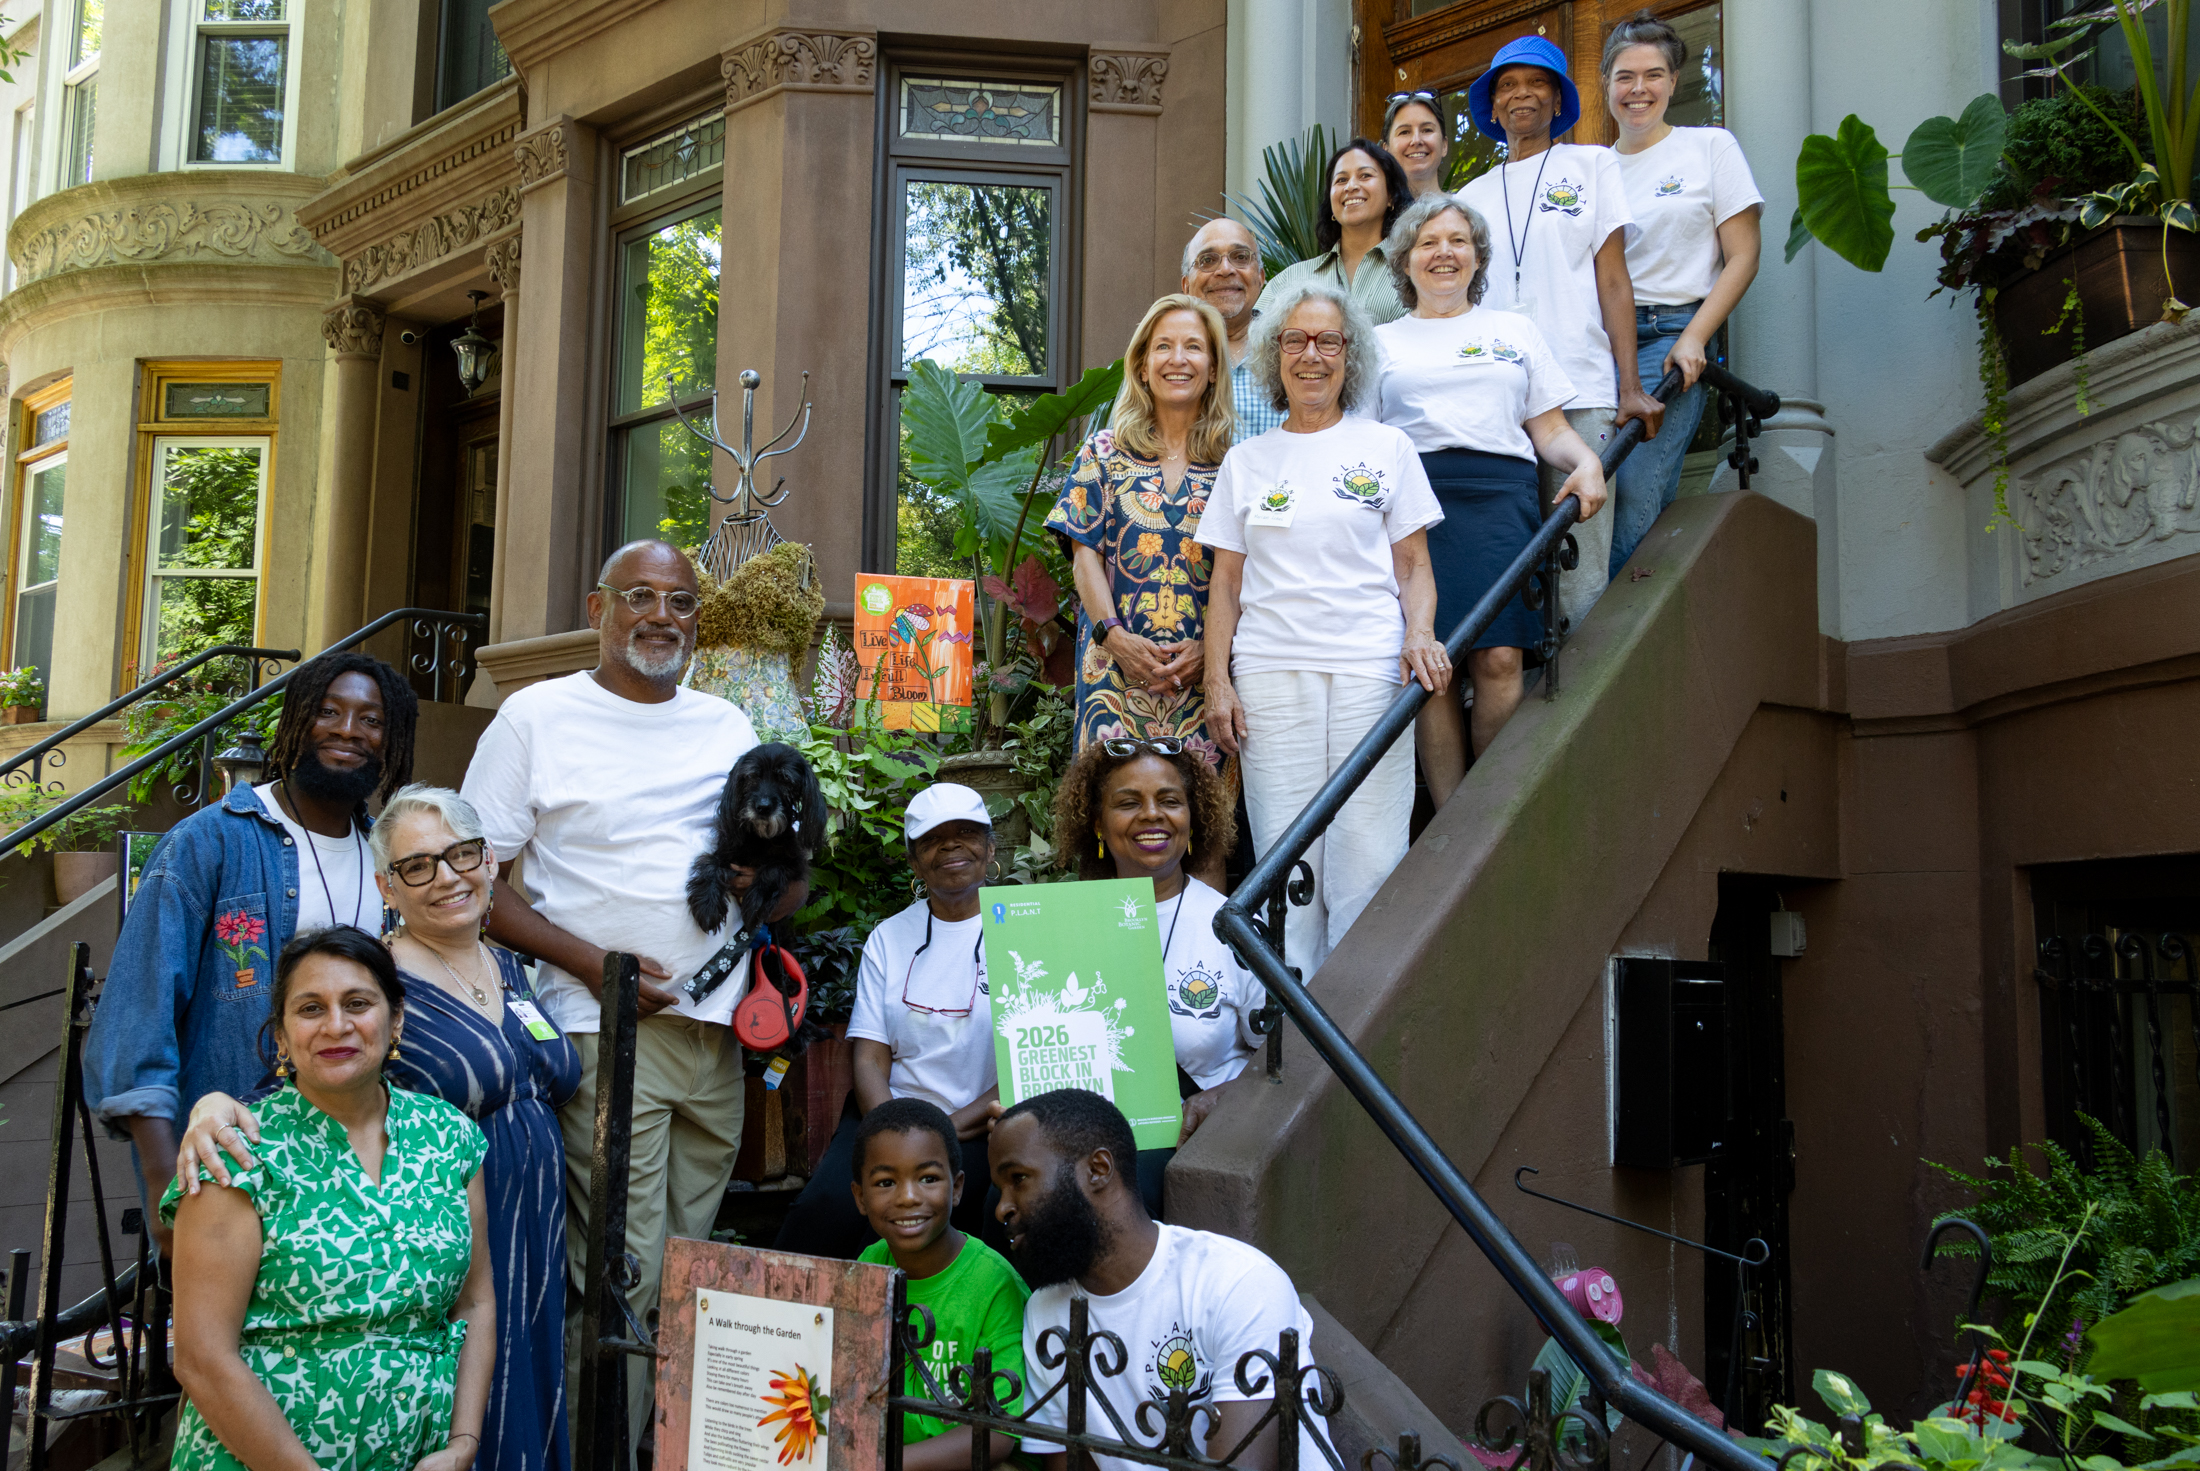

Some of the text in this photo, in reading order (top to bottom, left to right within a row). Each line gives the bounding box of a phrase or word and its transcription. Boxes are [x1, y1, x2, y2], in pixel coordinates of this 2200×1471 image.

[861, 632, 888, 647] Live
[892, 653, 915, 668] Life
[890, 687, 927, 700] Bloom
[1016, 1024, 1070, 1048] 2026
[1018, 1044, 1096, 1066] GREENEST
[1020, 1062, 1092, 1082] BLOCK IN
[709, 1317, 801, 1340] A Walk through the Garden
[932, 1340, 958, 1360] OF
[924, 1360, 963, 1382] YOU
